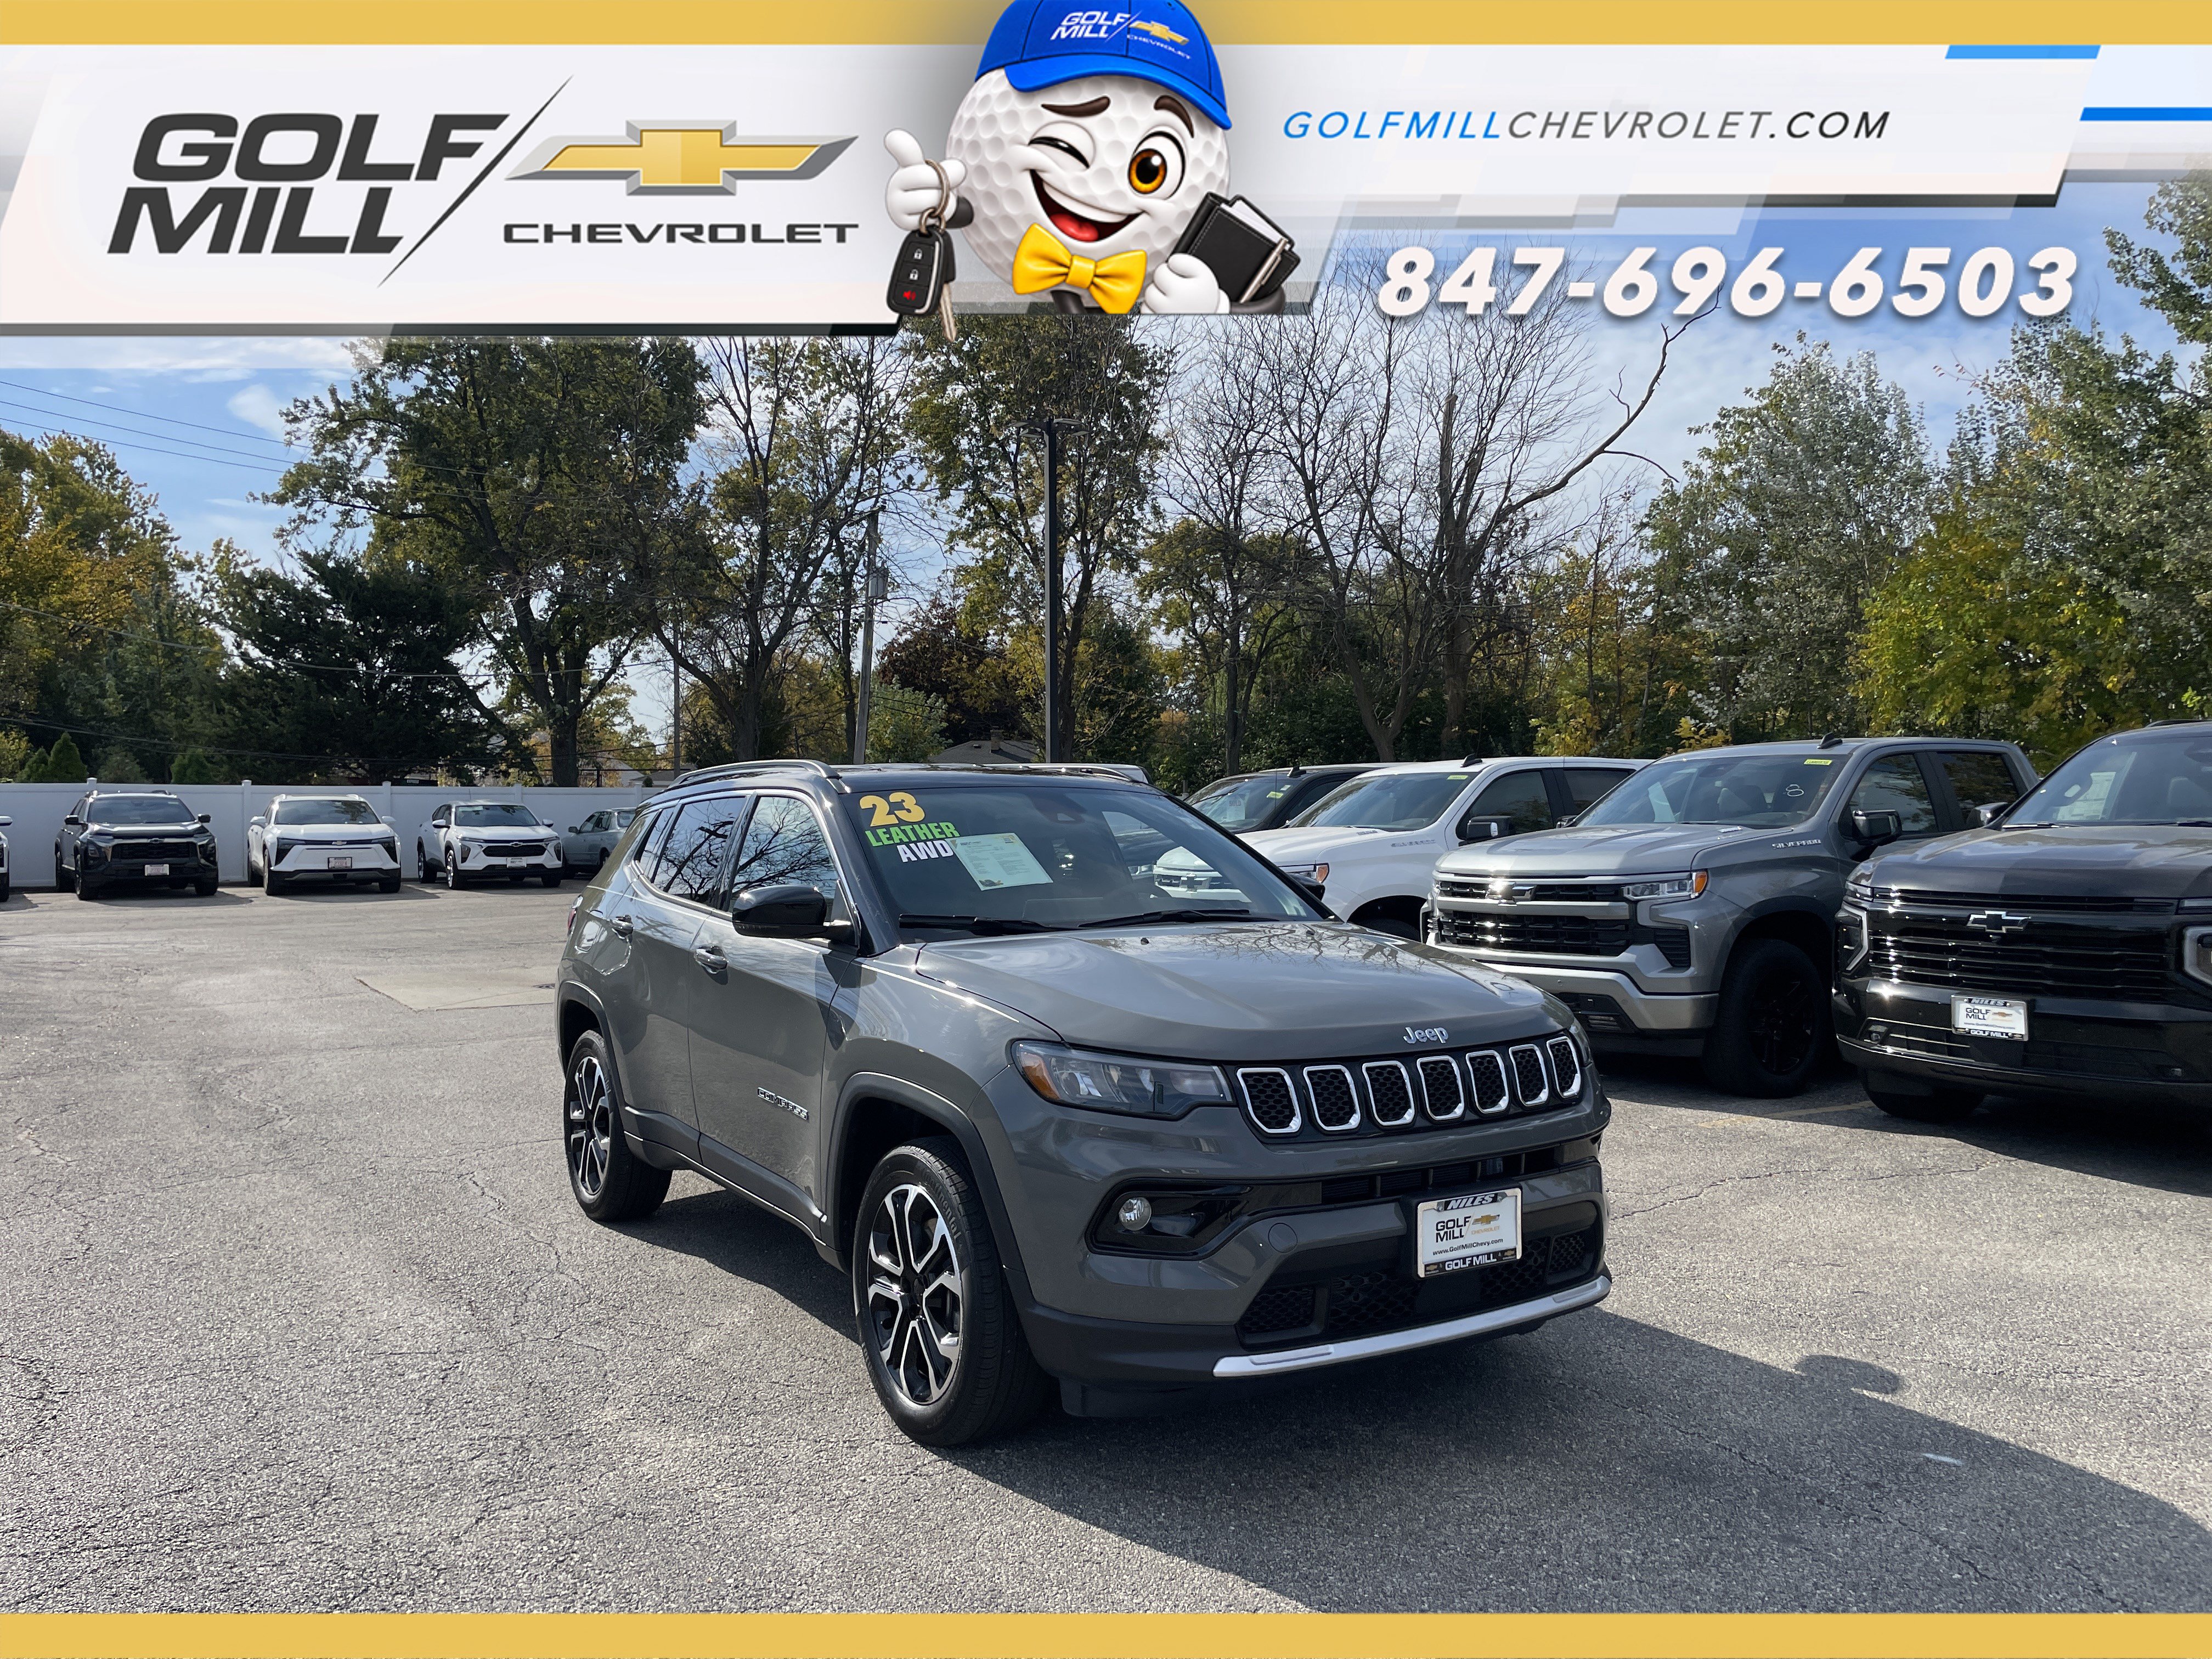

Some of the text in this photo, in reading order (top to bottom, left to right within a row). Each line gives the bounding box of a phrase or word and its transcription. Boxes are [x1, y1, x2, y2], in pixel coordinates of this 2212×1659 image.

[1785, 784, 1804, 797] 8
[859, 791, 926, 827] 23
[865, 822, 960, 847] LEATHER
[897, 840, 953, 862] AWD
[1772, 839, 1821, 849] SILVERADO
[1403, 1026, 1449, 1044] Jeep
[757, 1087, 809, 1120] COMPASS
[1447, 1194, 1494, 1210] NILES
[1436, 1216, 1471, 1231] GOLF
[1472, 1226, 1499, 1234] CHEVROLET
[1436, 1229, 1464, 1243] MILL
[1432, 1238, 1503, 1255] www.GolfMillChevy.com
[1445, 1254, 1497, 1271] GOLF MILL
